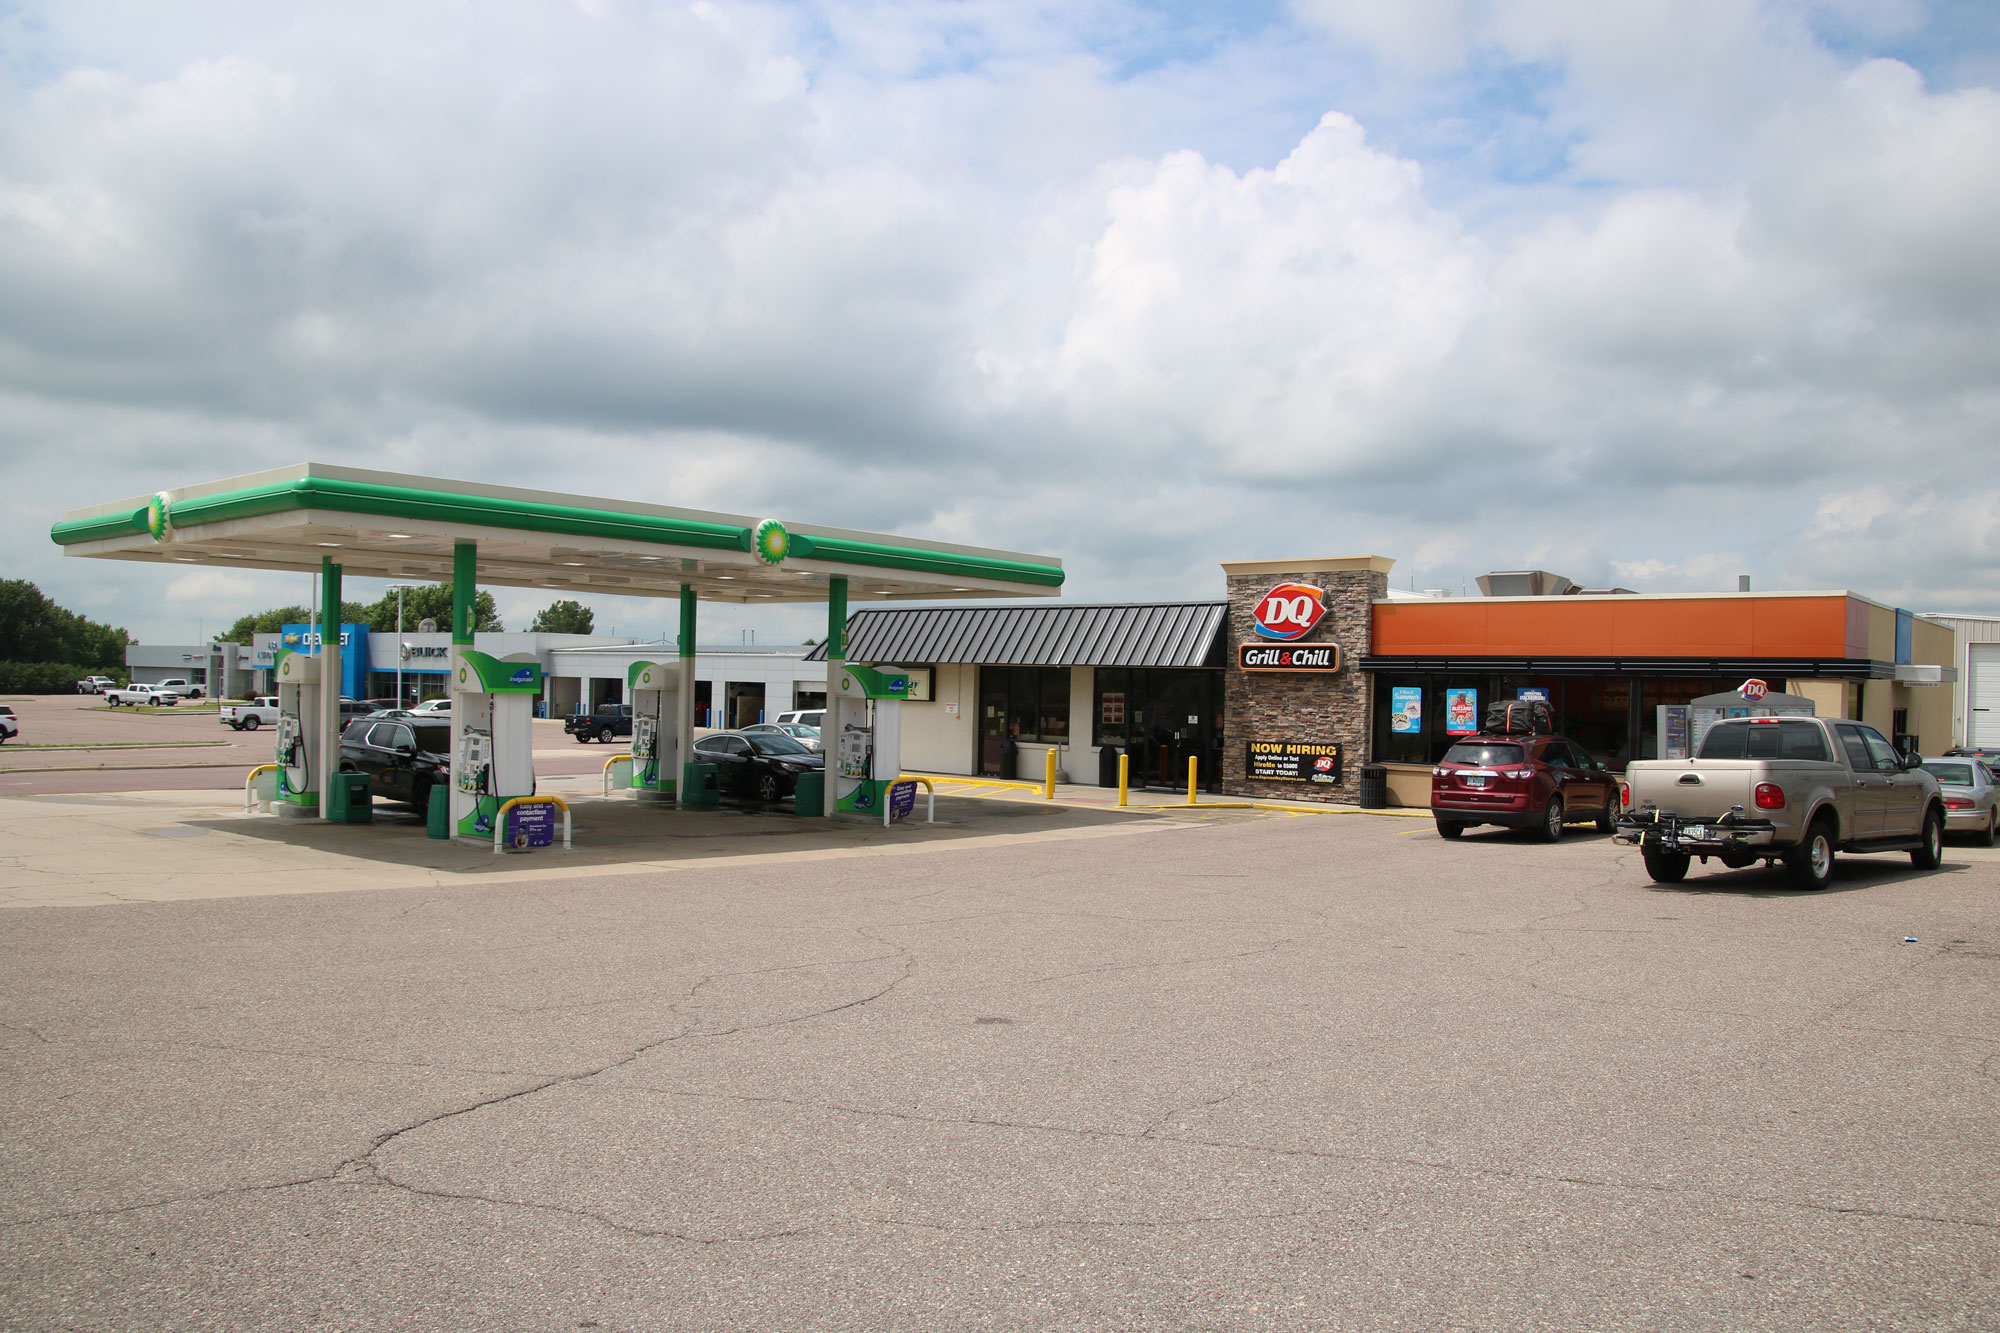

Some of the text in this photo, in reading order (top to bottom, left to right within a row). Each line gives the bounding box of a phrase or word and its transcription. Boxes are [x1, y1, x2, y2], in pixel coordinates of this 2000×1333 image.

[1264, 596, 1313, 627] DQ
[411, 646, 448, 657] BUICK
[1747, 683, 1765, 697] DQ
[1251, 743, 1337, 755] NOW HIRING
[1316, 759, 1331, 769] DQ
